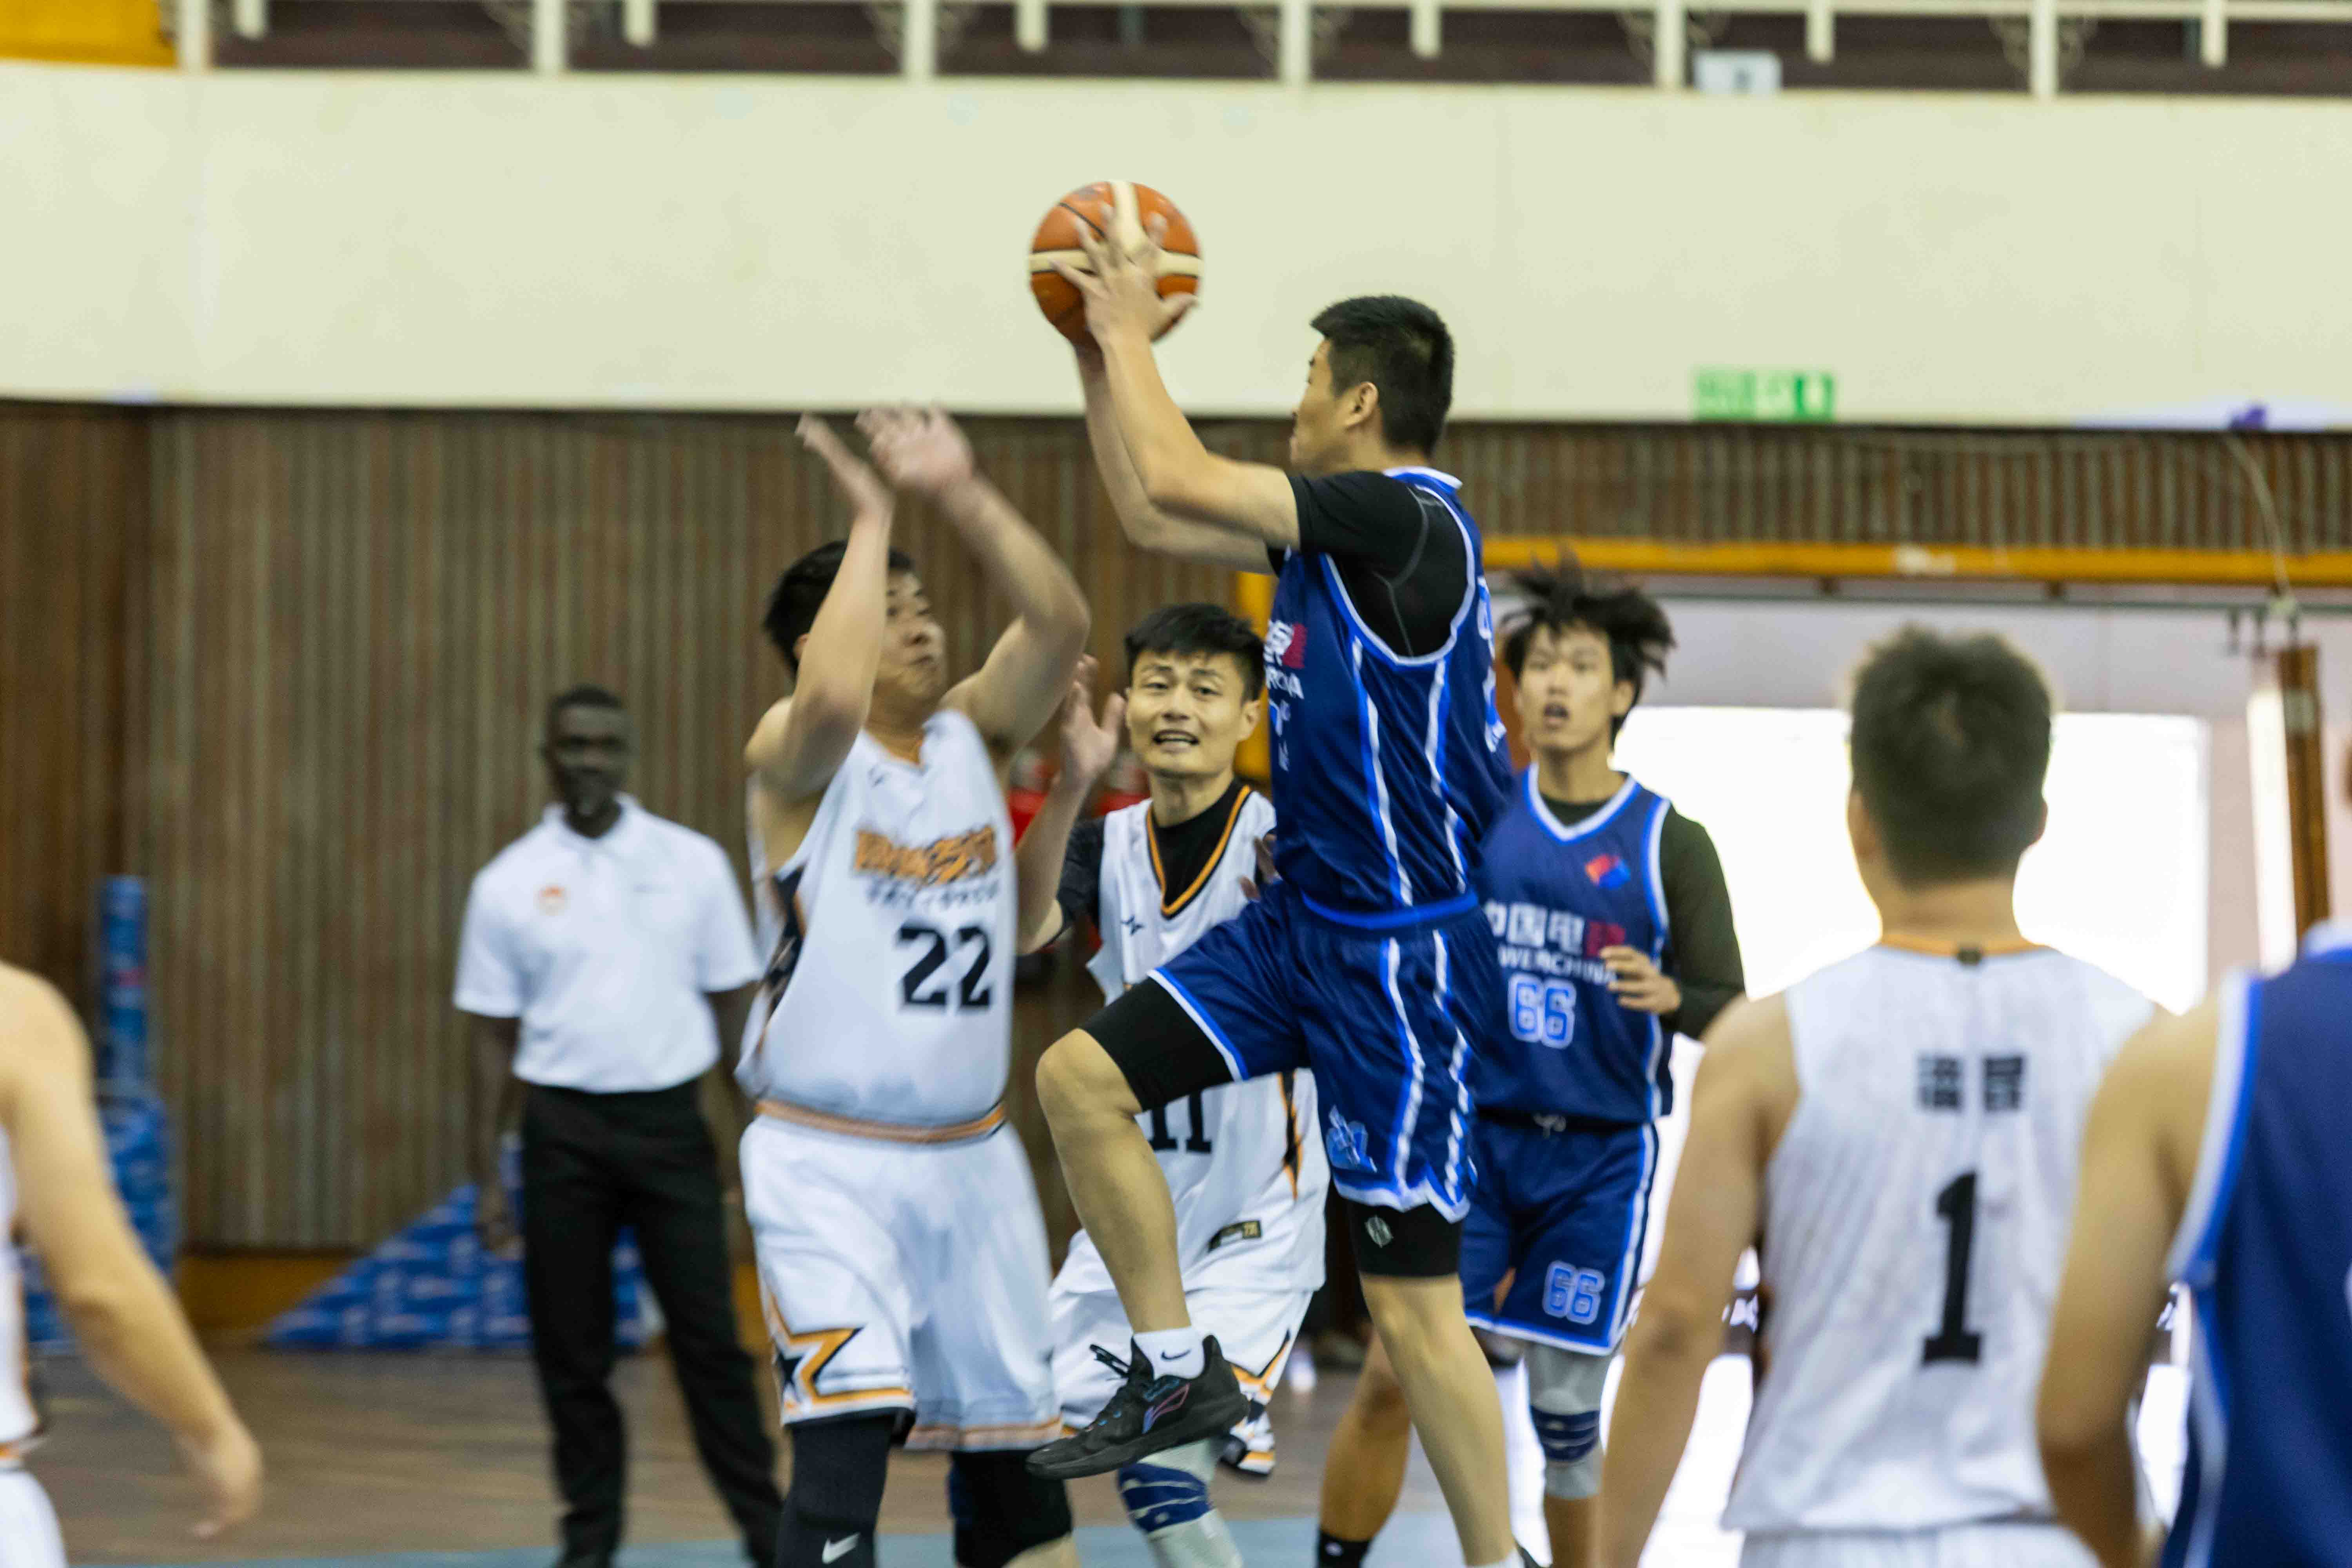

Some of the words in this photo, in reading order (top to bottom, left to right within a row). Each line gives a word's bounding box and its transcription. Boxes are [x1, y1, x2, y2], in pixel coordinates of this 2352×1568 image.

[897, 924, 991, 1007] 22
[1508, 971, 1577, 1049] 66
[1543, 1261, 1606, 1325] 66
[1922, 1168, 1982, 1365] 1
